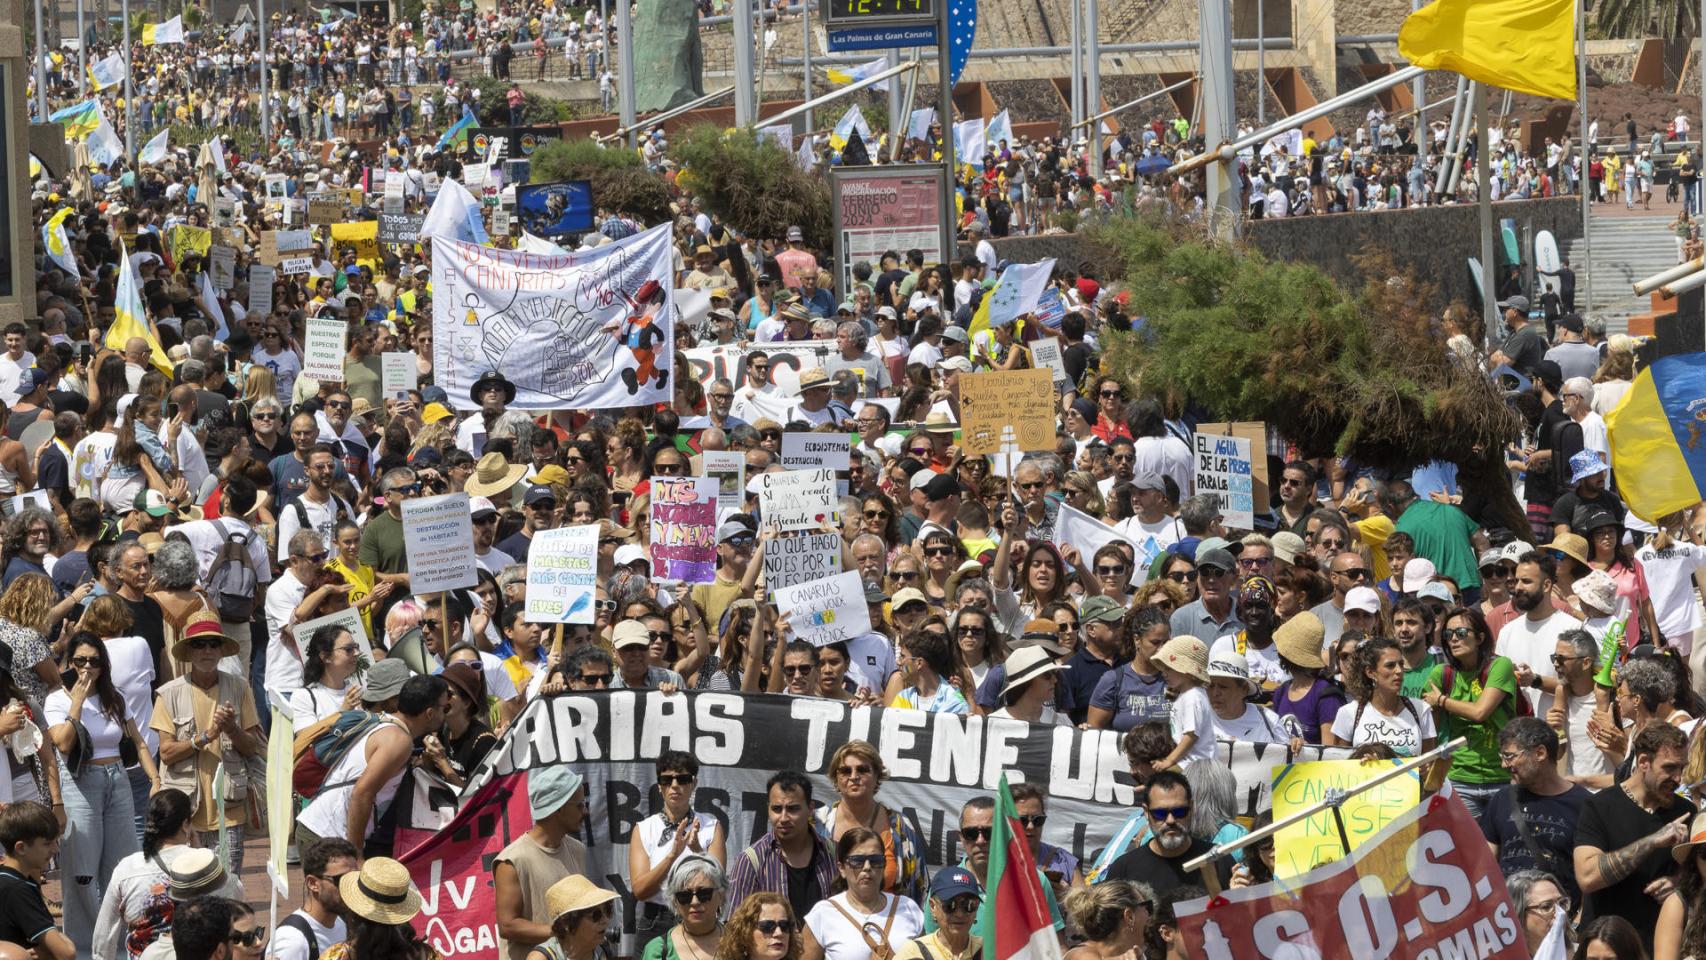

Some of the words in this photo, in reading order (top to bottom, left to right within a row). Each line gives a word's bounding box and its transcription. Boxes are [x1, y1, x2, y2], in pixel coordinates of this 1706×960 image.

[848, 35, 873, 43] Palmas
[874, 33, 884, 41] de
[885, 32, 903, 40] Gran
[904, 31, 933, 39] Canaria
[842, 187, 897, 196] PROGRAMACIÓN
[842, 193, 898, 206] FEBRERO
[843, 204, 881, 217] JUNIO
[382, 215, 408, 223] TODOS
[843, 215, 872, 226] 2024
[456, 241, 480, 264] NO
[463, 264, 567, 291] CANARIAS
[307, 320, 345, 328] DEFENDEMOS
[311, 331, 340, 339] NUESTRAS
[311, 341, 338, 349] ESPECIES
[312, 352, 336, 360] PORQUE
[306, 362, 341, 371] VALORAMOS
[304, 372, 329, 380] NUESTRA
[804, 441, 850, 453] ECOSISTEMAS
[1197, 436, 1211, 453] EL
[1215, 440, 1238, 457] AGUA
[1201, 455, 1212, 471] DE
[1215, 457, 1228, 473] LAS
[1197, 473, 1217, 490] PARA
[443, 501, 465, 510] SUELO
[416, 521, 461, 534] DESTRUCCIÓN
[765, 540, 780, 556] LO
[784, 538, 808, 554] QUE
[811, 534, 838, 551] HAGO
[414, 551, 425, 559] POR
[438, 545, 470, 556] TRANSICIÓN
[533, 555, 592, 571] MALETAS,
[765, 557, 782, 573] NO
[784, 556, 798, 573] ES
[802, 553, 826, 571] POR
[438, 565, 466, 575] personas
[530, 568, 557, 585] MÁS
[432, 573, 464, 582] naturaleza
[553, 586, 567, 597] DE
[790, 579, 840, 605] CANARIAS
[529, 599, 564, 615] AVES
[791, 605, 804, 617] NO
[492, 690, 746, 776] ARIAS
[790, 698, 1030, 791] TIENE
[1049, 725, 1136, 806] UN
[1253, 828, 1494, 960] SO.S.
